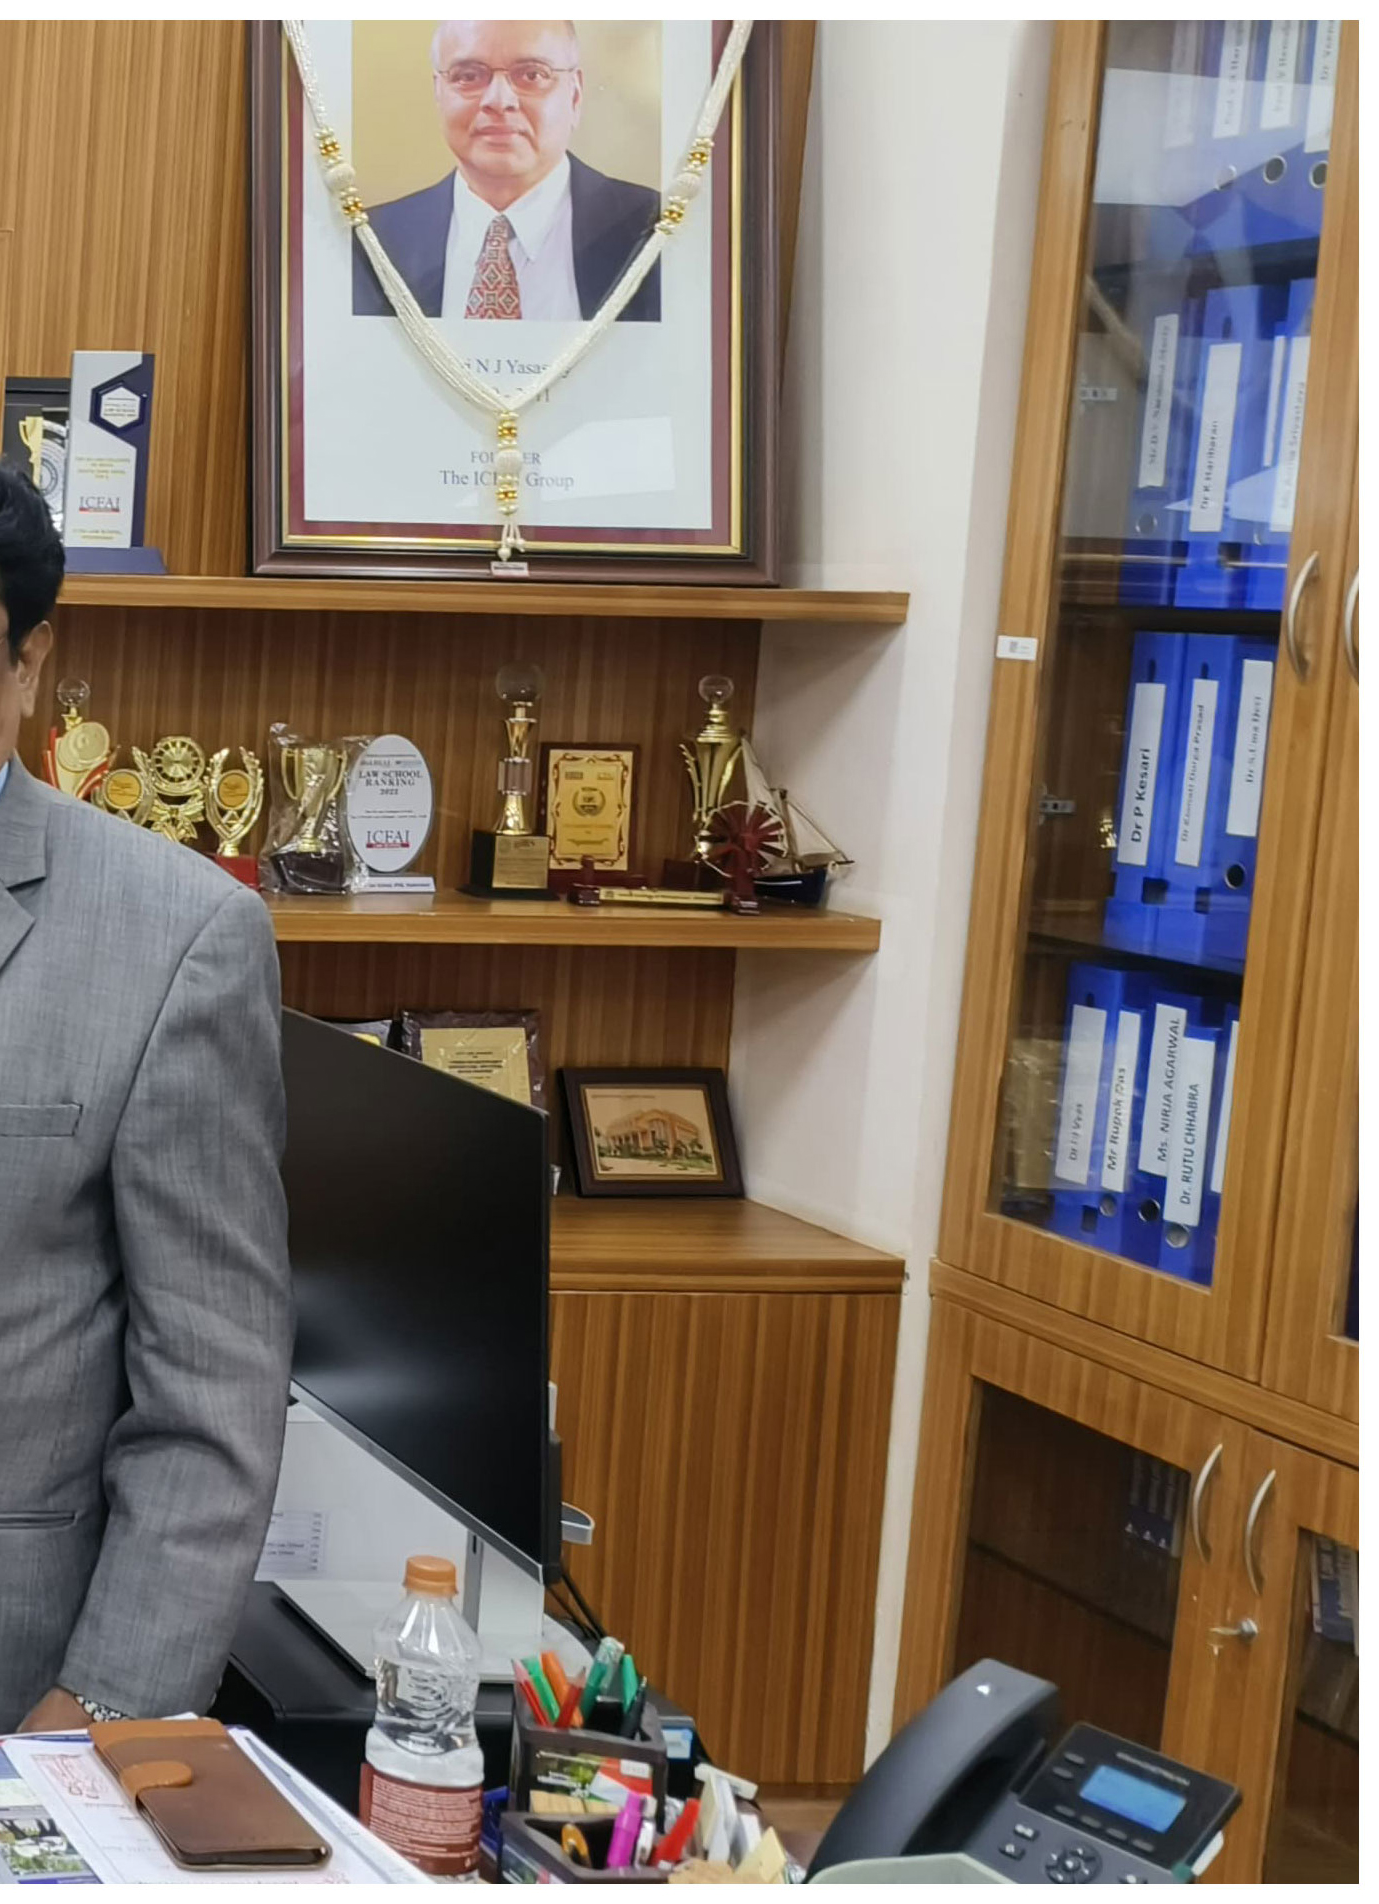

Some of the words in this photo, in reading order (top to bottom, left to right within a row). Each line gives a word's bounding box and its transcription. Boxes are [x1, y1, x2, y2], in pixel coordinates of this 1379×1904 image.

[476, 359, 490, 373] N
[494, 359, 502, 374] J
[439, 470, 469, 485] The
[525, 471, 574, 490] Group
[79, 496, 121, 509] ICFAI
[359, 771, 381, 779] LAW
[382, 771, 423, 779] SCHOOL
[365, 779, 416, 787] RANKING
[1136, 748, 1151, 801] Kesari
[380, 788, 399, 796] 2022
[1134, 806, 1144, 817] P
[366, 830, 411, 843] ICFAI
[1131, 824, 1143, 843] Dr
[1165, 1018, 1181, 1090] AGARWAL
[1160, 1092, 1173, 1133] NIRJA
[1185, 1083, 1200, 1149] CHHABRA
[1157, 1138, 1169, 1162] Ms.
[1106, 1149, 1119, 1171] Mr
[1182, 1150, 1195, 1185] RUTU
[1180, 1187, 1191, 1206] Dr.
